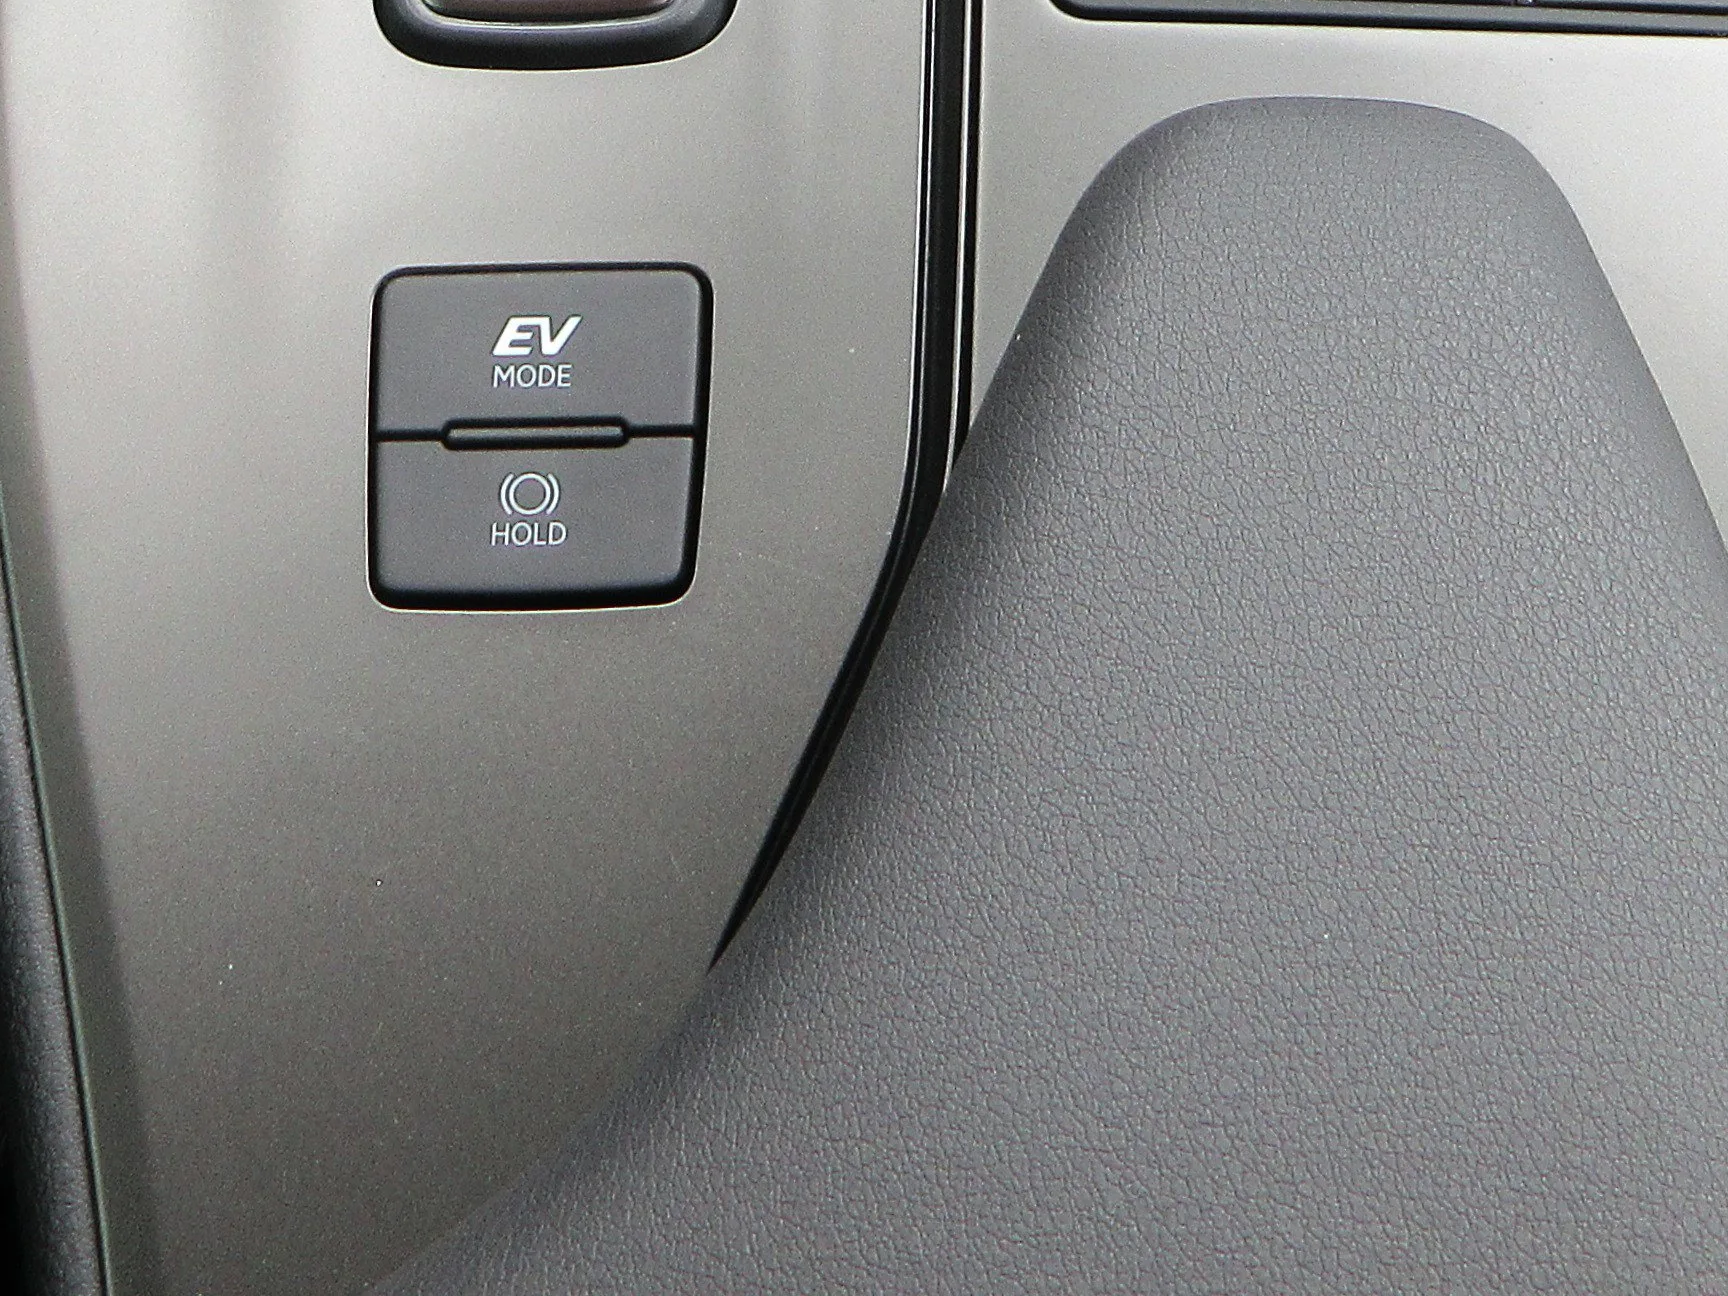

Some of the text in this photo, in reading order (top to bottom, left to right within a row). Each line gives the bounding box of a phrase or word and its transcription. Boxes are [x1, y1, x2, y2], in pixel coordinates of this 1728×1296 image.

[491, 314, 583, 357] EV
[492, 364, 572, 389] MODE
[490, 521, 568, 547] HOLD
